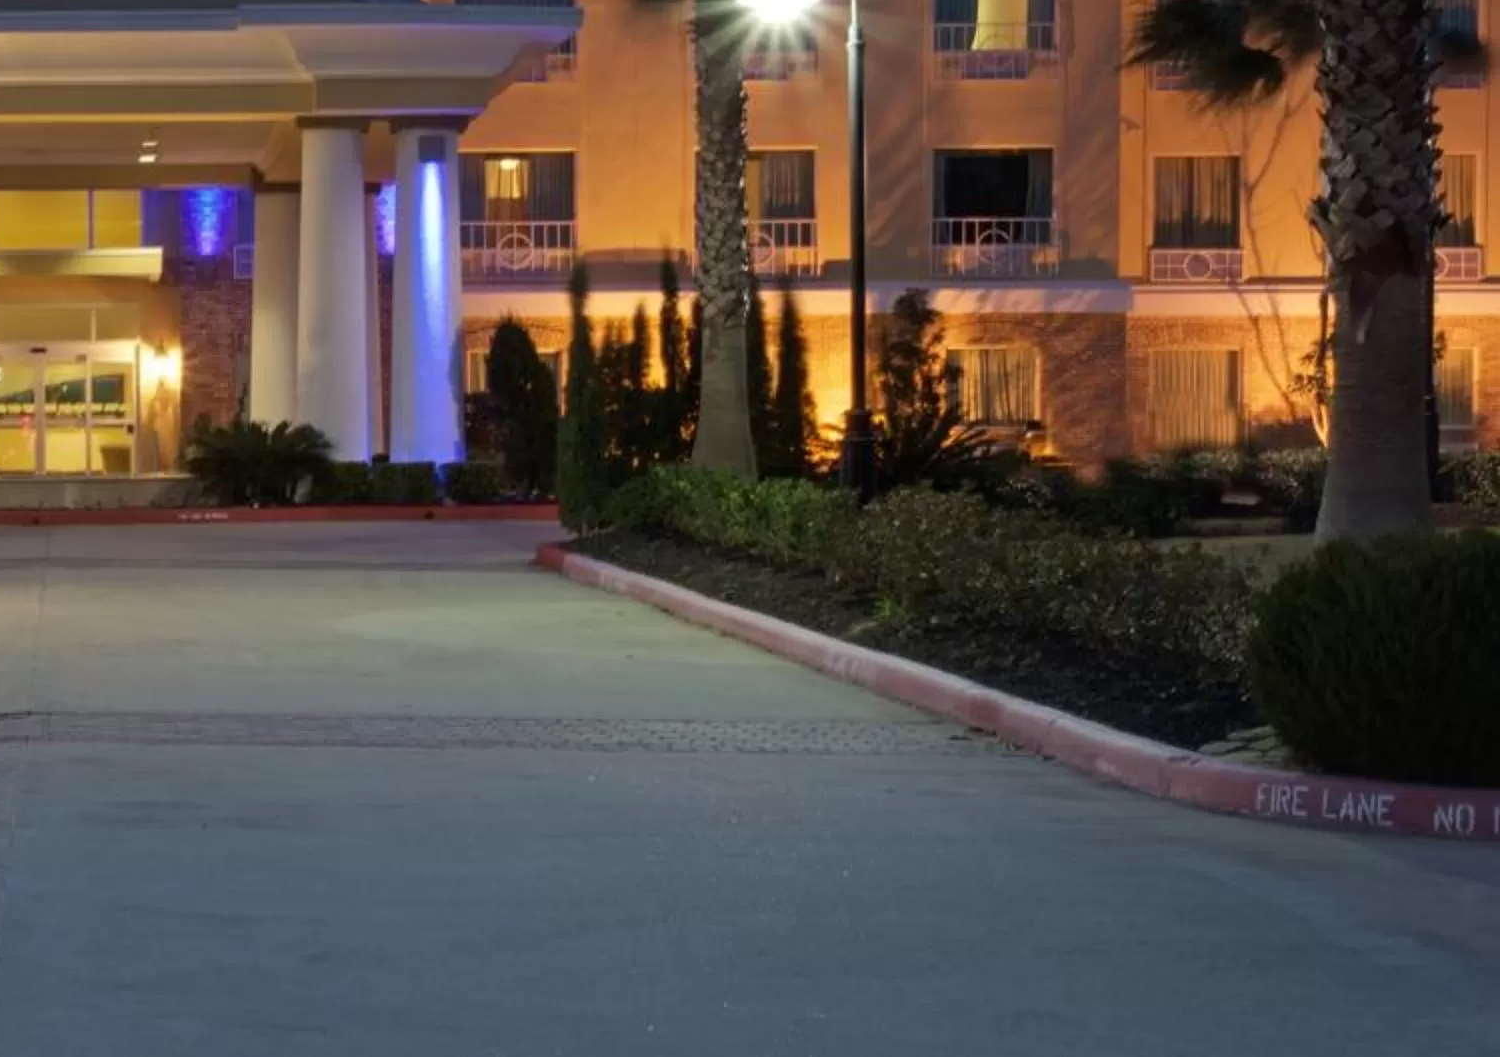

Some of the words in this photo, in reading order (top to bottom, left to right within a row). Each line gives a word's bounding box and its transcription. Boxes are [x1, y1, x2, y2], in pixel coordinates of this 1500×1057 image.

[1256, 783, 1309, 817] FIRE
[1321, 789, 1394, 827] LANE
[1433, 803, 1476, 835] NO
